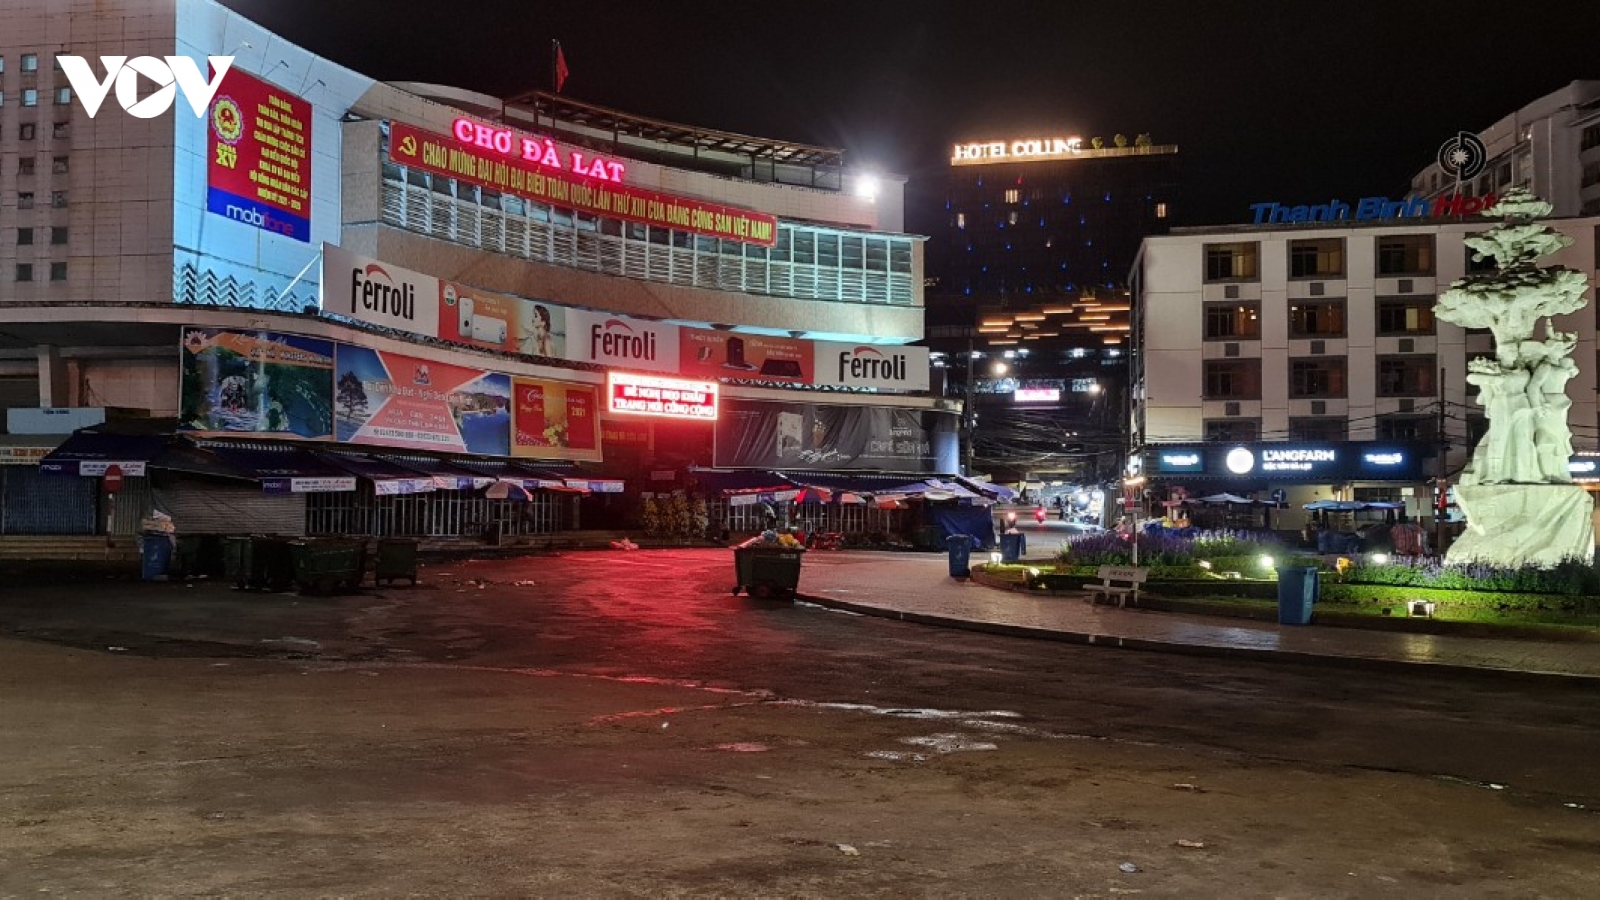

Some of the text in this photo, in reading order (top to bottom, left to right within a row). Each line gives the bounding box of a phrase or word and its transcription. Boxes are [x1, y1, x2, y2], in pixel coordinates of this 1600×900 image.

[523, 136, 561, 168] ĐÀ
[954, 142, 1005, 159] HOTEL
[424, 140, 447, 169] CHÀO
[450, 148, 475, 176] MỪNG
[478, 157, 492, 186] ĐẠI
[494, 162, 508, 190] HỘI
[526, 165, 544, 196] BIỂU
[547, 174, 569, 200] TOÀN
[571, 179, 592, 207] QUỐC
[593, 183, 611, 212] LẦN
[613, 192, 630, 216] THỨ
[631, 196, 645, 218] XIII
[648, 195, 665, 222] CỦA
[667, 199, 690, 227] ĐẢNG
[691, 206, 713, 232] CỘNG
[716, 208, 732, 234] SẢN
[734, 216, 749, 241] VIỆT
[751, 221, 772, 241] NAM!
[226, 204, 294, 235] mobifone
[1249, 199, 1349, 225] Thanh
[1433, 192, 1500, 216] Hot
[351, 267, 414, 320] Ferroli
[590, 324, 656, 361] Ferroli
[838, 350, 906, 382] Ferroli
